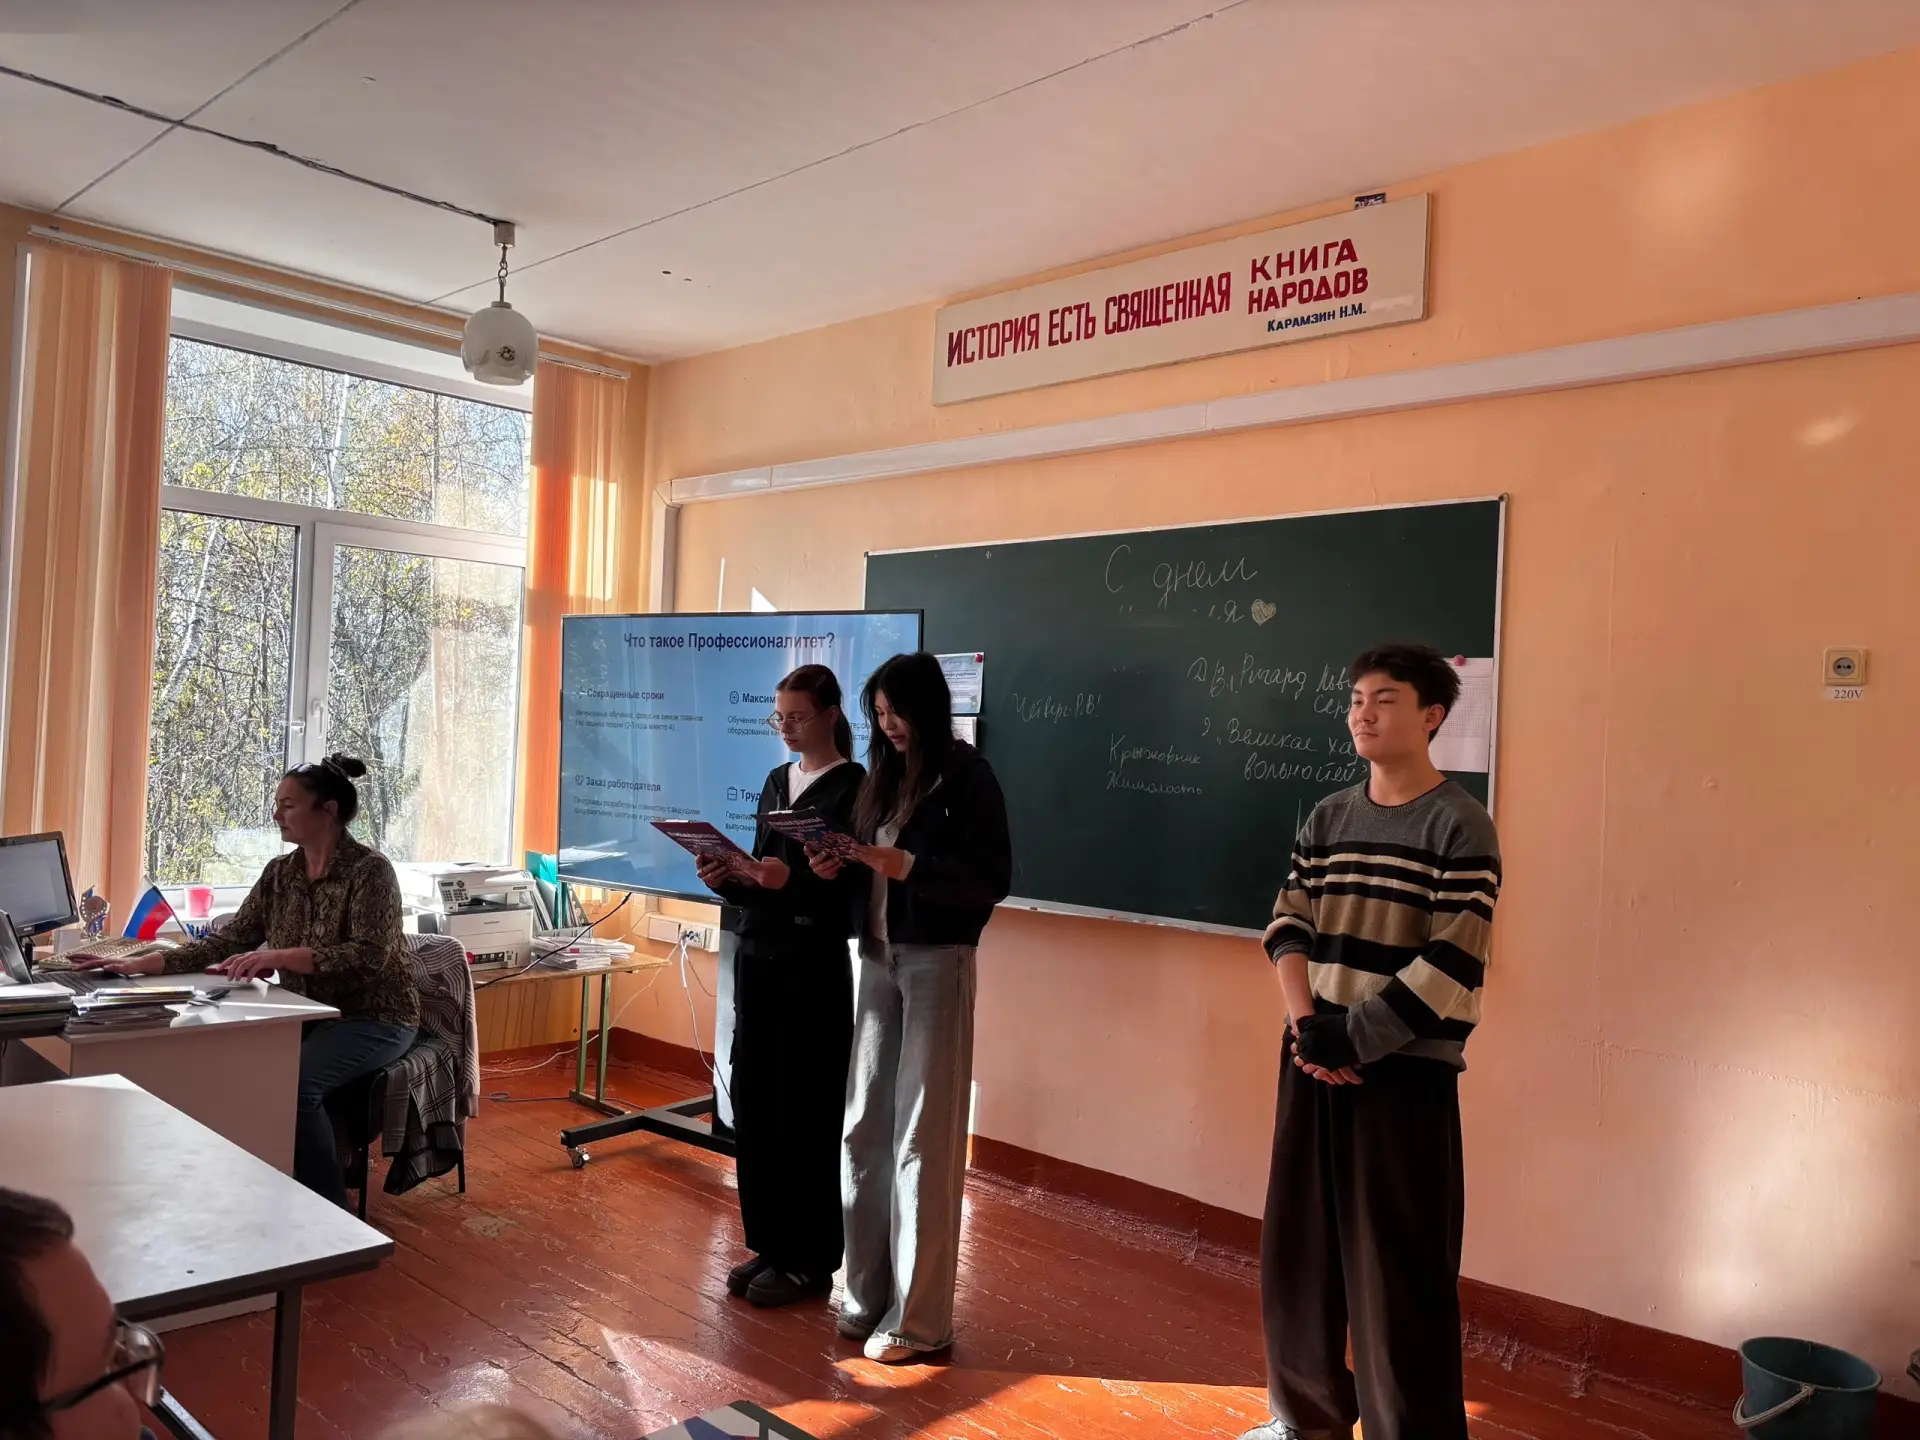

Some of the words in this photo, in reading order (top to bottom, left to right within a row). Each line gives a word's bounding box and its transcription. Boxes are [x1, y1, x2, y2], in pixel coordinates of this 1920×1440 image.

[1250, 238, 1358, 284] КНИГА
[1247, 267, 1369, 315] НАРОДОВ
[1339, 302, 1367, 319] Н.М.
[947, 314, 1040, 368] ИСТОРИЯ
[1047, 306, 1096, 348] ЕСТЬ
[1104, 271, 1232, 336] СВЯЩЕННАЯ
[624, 632, 646, 648] Что
[649, 634, 684, 648] такое
[688, 631, 835, 651] Профессионалитет?
[587, 687, 639, 700] Сокращенные
[641, 691, 664, 702] сроки
[742, 692, 776, 704] Максим
[1834, 689, 1864, 699] 220V
[727, 715, 757, 726] Обучение
[1109, 733, 1201, 768] Крыжовник
[585, 776, 606, 787] Заказ
[607, 778, 661, 792] работодателя
[740, 788, 761, 802] Труд
